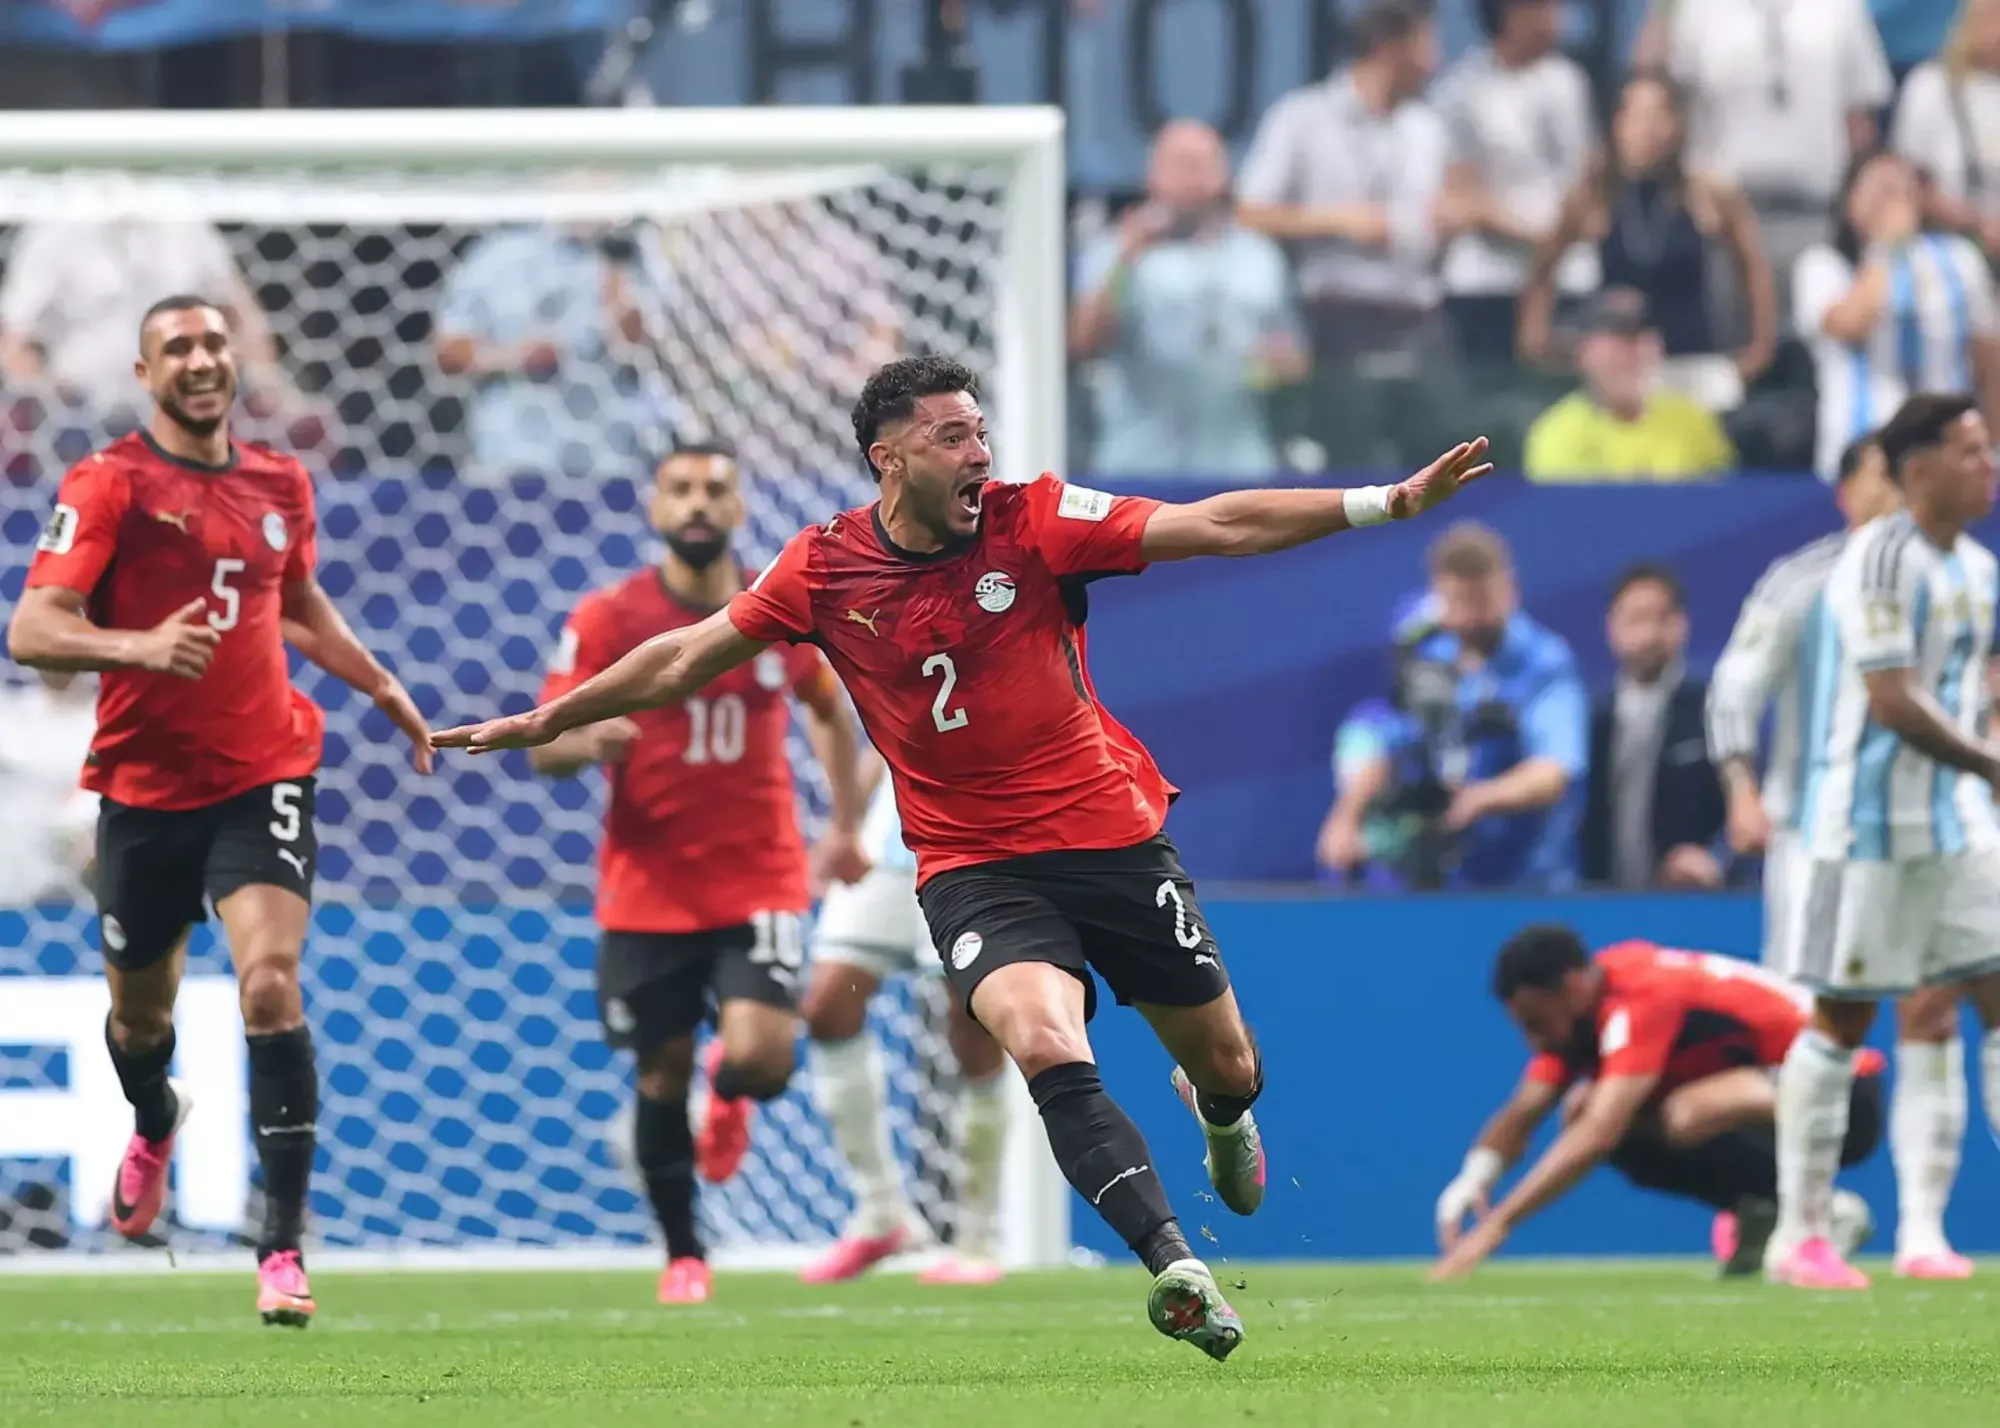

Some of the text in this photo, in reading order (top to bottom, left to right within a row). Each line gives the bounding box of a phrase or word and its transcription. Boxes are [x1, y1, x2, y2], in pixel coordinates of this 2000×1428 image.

[208, 557, 246, 631] 5
[921, 652, 969, 733] 2
[681, 693, 748, 764] 10
[269, 782, 303, 842] 5
[747, 909, 803, 969] 10
[1155, 879, 1202, 949] 2
